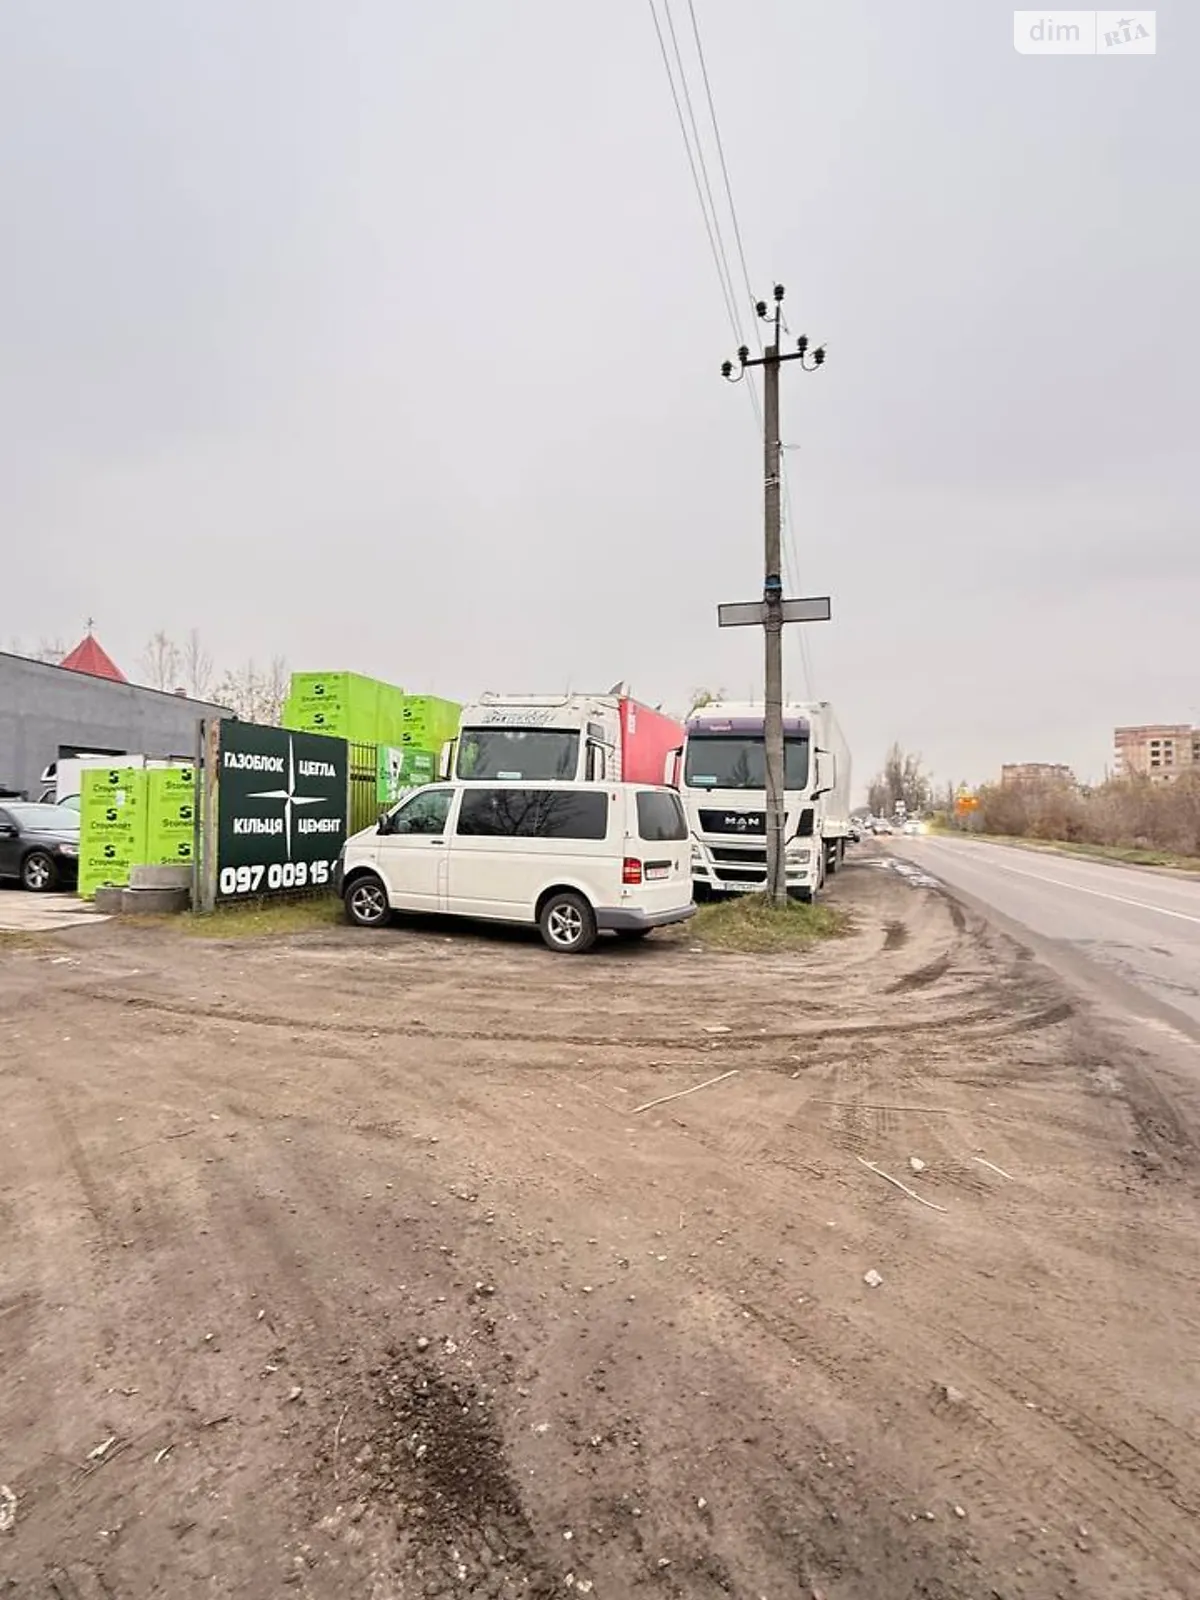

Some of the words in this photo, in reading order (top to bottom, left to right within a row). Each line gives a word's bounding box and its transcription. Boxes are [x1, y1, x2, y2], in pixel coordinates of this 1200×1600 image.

[224, 751, 284, 773] ГАЗОБЛОК
[299, 760, 336, 777] ЦЕГЛА
[233, 818, 283, 835] КІЛЬЦЯ
[298, 818, 341, 834] ЦЕМЕНТ
[725, 817, 759, 826] MAN
[220, 865, 265, 894] 097
[268, 862, 307, 889] 009
